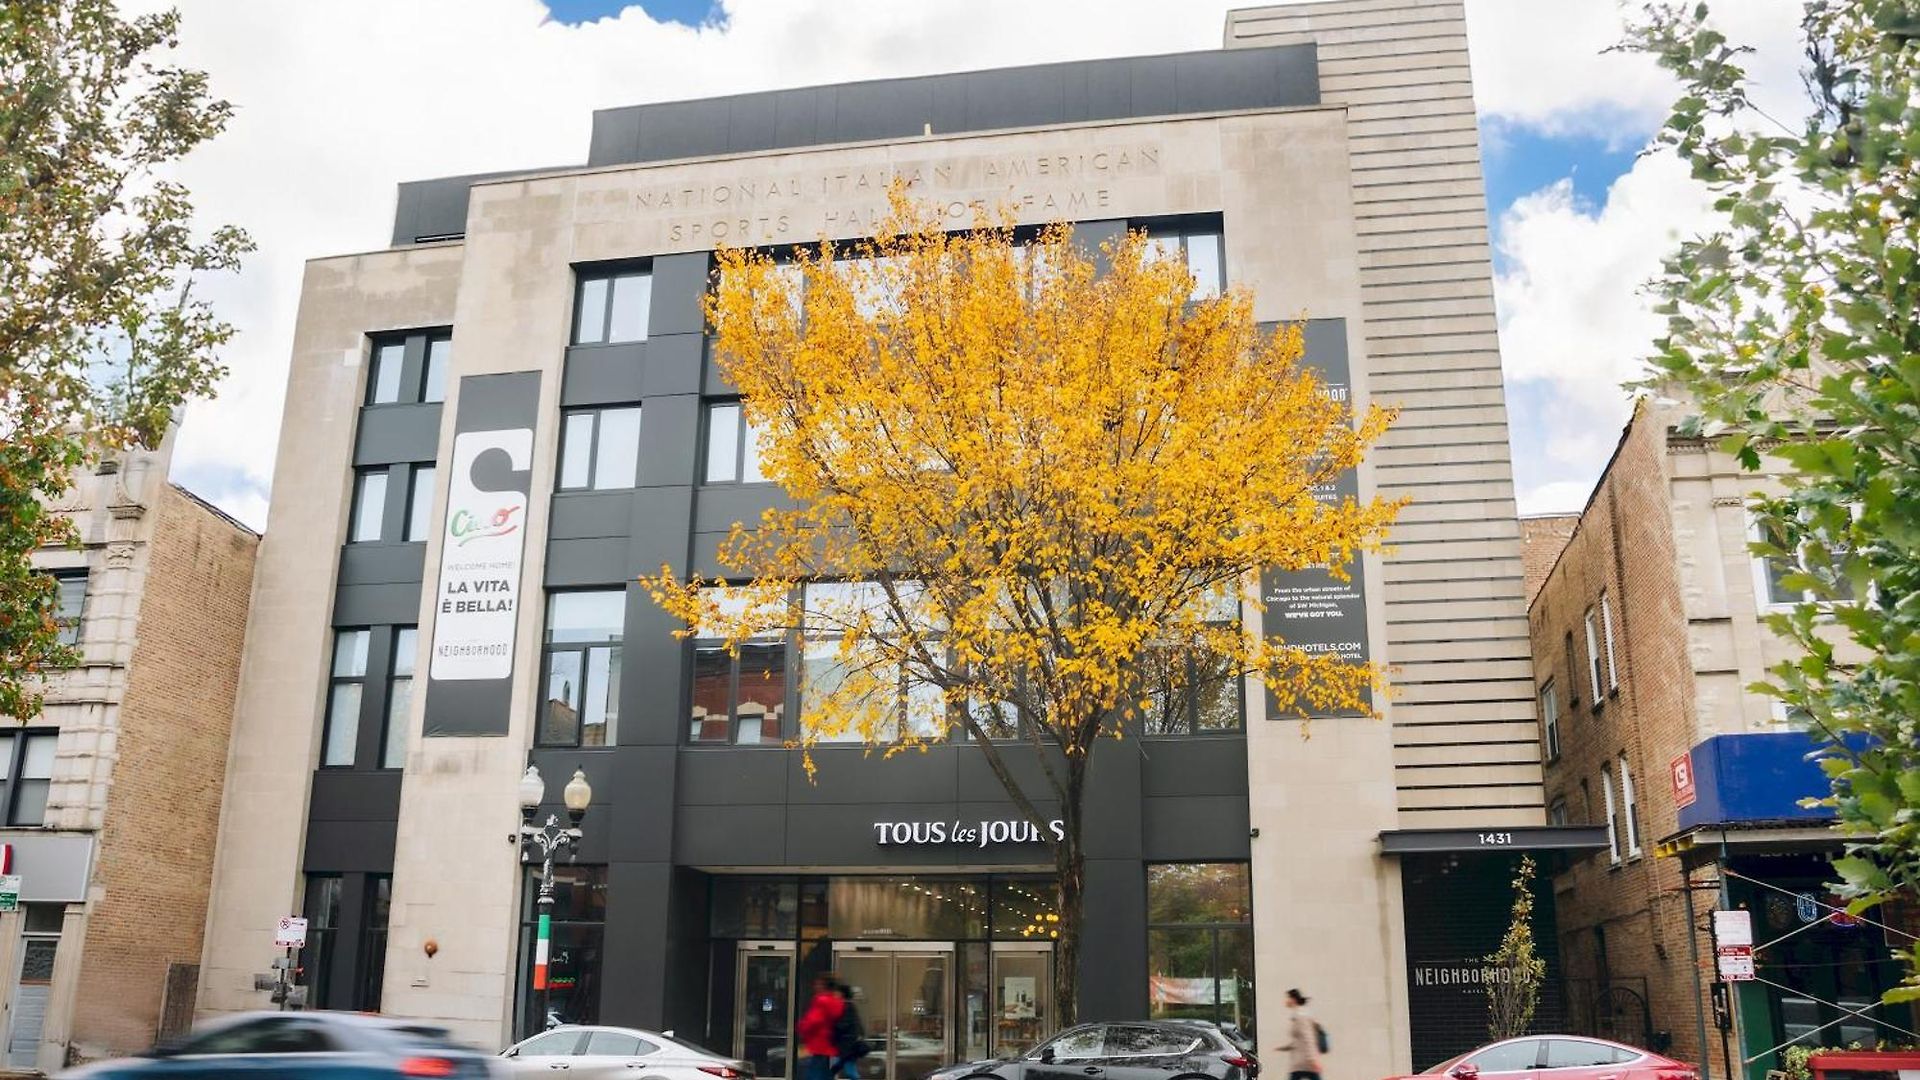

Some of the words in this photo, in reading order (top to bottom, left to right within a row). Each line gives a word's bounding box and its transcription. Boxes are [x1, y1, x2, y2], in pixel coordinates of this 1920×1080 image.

[635, 179, 800, 209] NATIONAL
[823, 165, 951, 194] ITALAN
[985, 148, 1160, 179] AMERICAN
[669, 215, 790, 242] SPORTS
[824, 206, 893, 229] HAL
[947, 198, 985, 219] O
[1022, 189, 1109, 212] FAME
[447, 561, 487, 571] WELCOME
[447, 581, 468, 594] LA
[474, 580, 510, 592] VITA
[455, 599, 513, 613] BELLA!
[438, 643, 508, 657] NEIGHBORHOOD
[873, 821, 947, 845] TOUS
[951, 819, 976, 843] les
[1478, 833, 1512, 845] 1431
[1415, 967, 1534, 987] NEIGHBORHOD
